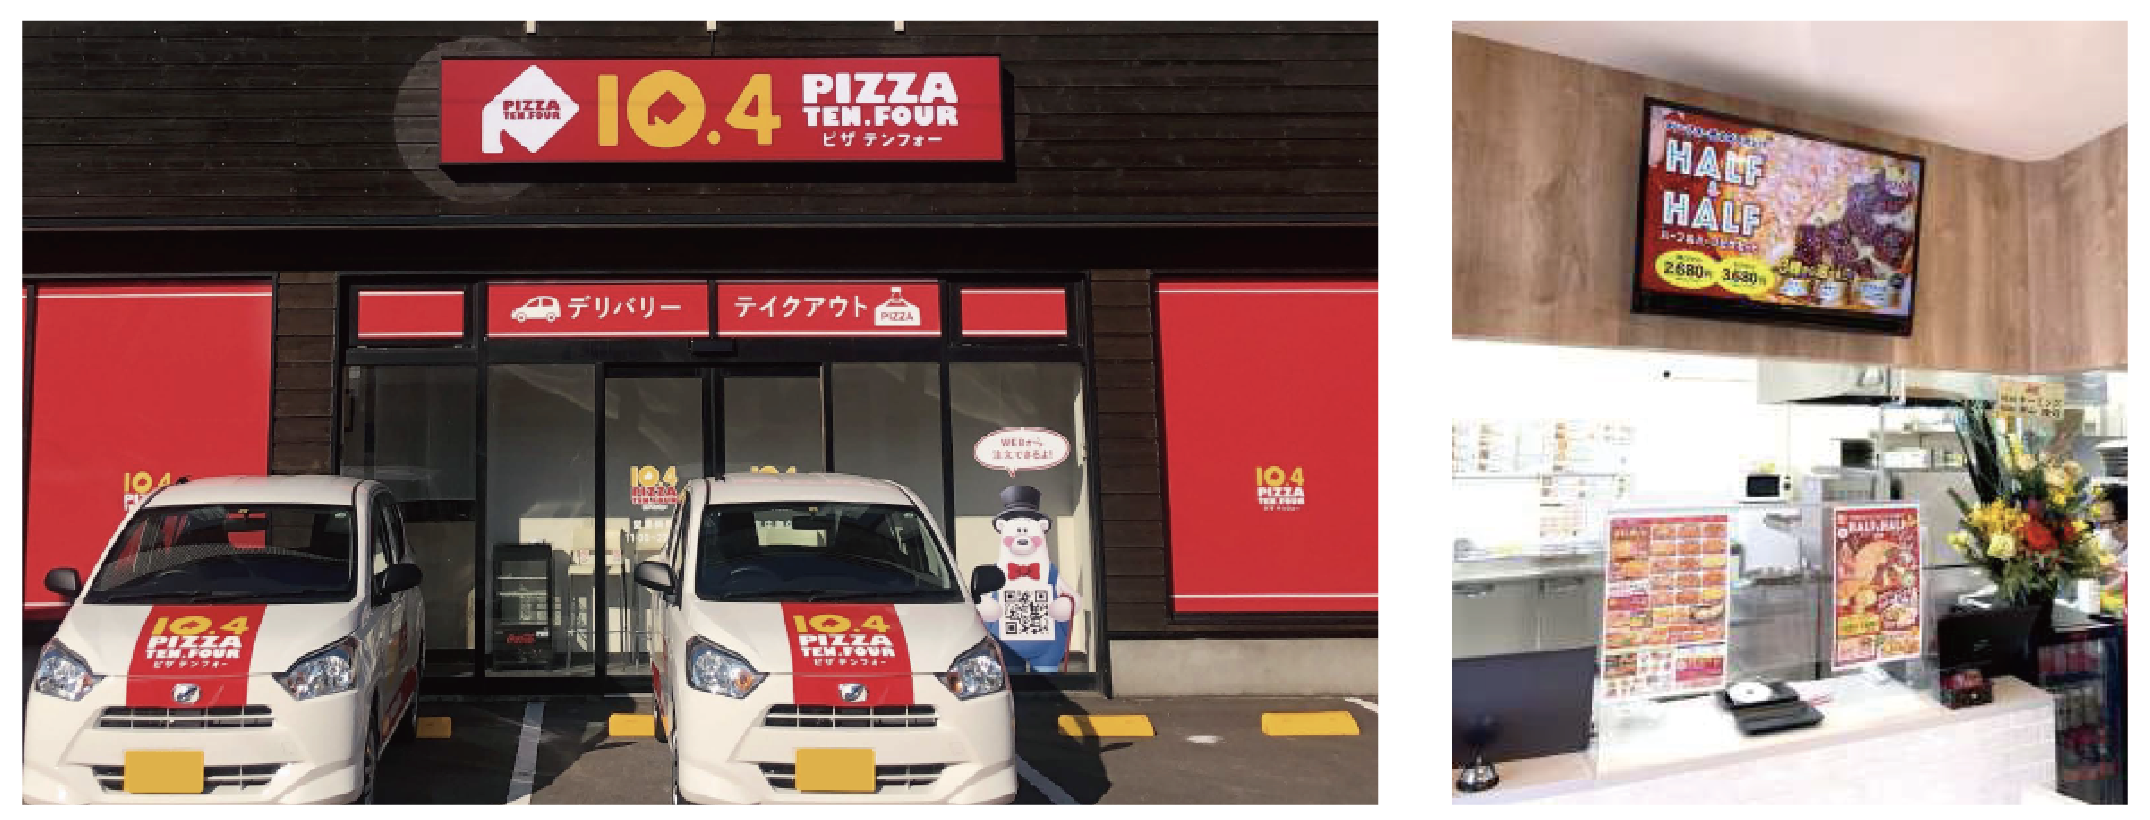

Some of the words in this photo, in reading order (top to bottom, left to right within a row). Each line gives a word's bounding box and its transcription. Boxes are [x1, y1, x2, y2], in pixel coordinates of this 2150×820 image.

[802, 71, 959, 104] PIZZA
[502, 99, 561, 111] PIZZA
[597, 69, 781, 147] 10.4
[802, 105, 959, 127] TEN.FOUR
[1666, 139, 1766, 187] HALF
[1662, 191, 1761, 236] HALF
[567, 295, 682, 320] デリバリー
[734, 295, 868, 318] テイクアウト
[880, 311, 914, 322] PIZZA
[1255, 465, 1305, 487] 10.4
[1257, 486, 1305, 497] PIZZA
[152, 615, 249, 636] 10.4
[793, 614, 891, 633] 10.4
[146, 635, 243, 649] PIZZA
[799, 633, 894, 646] PIZZA
